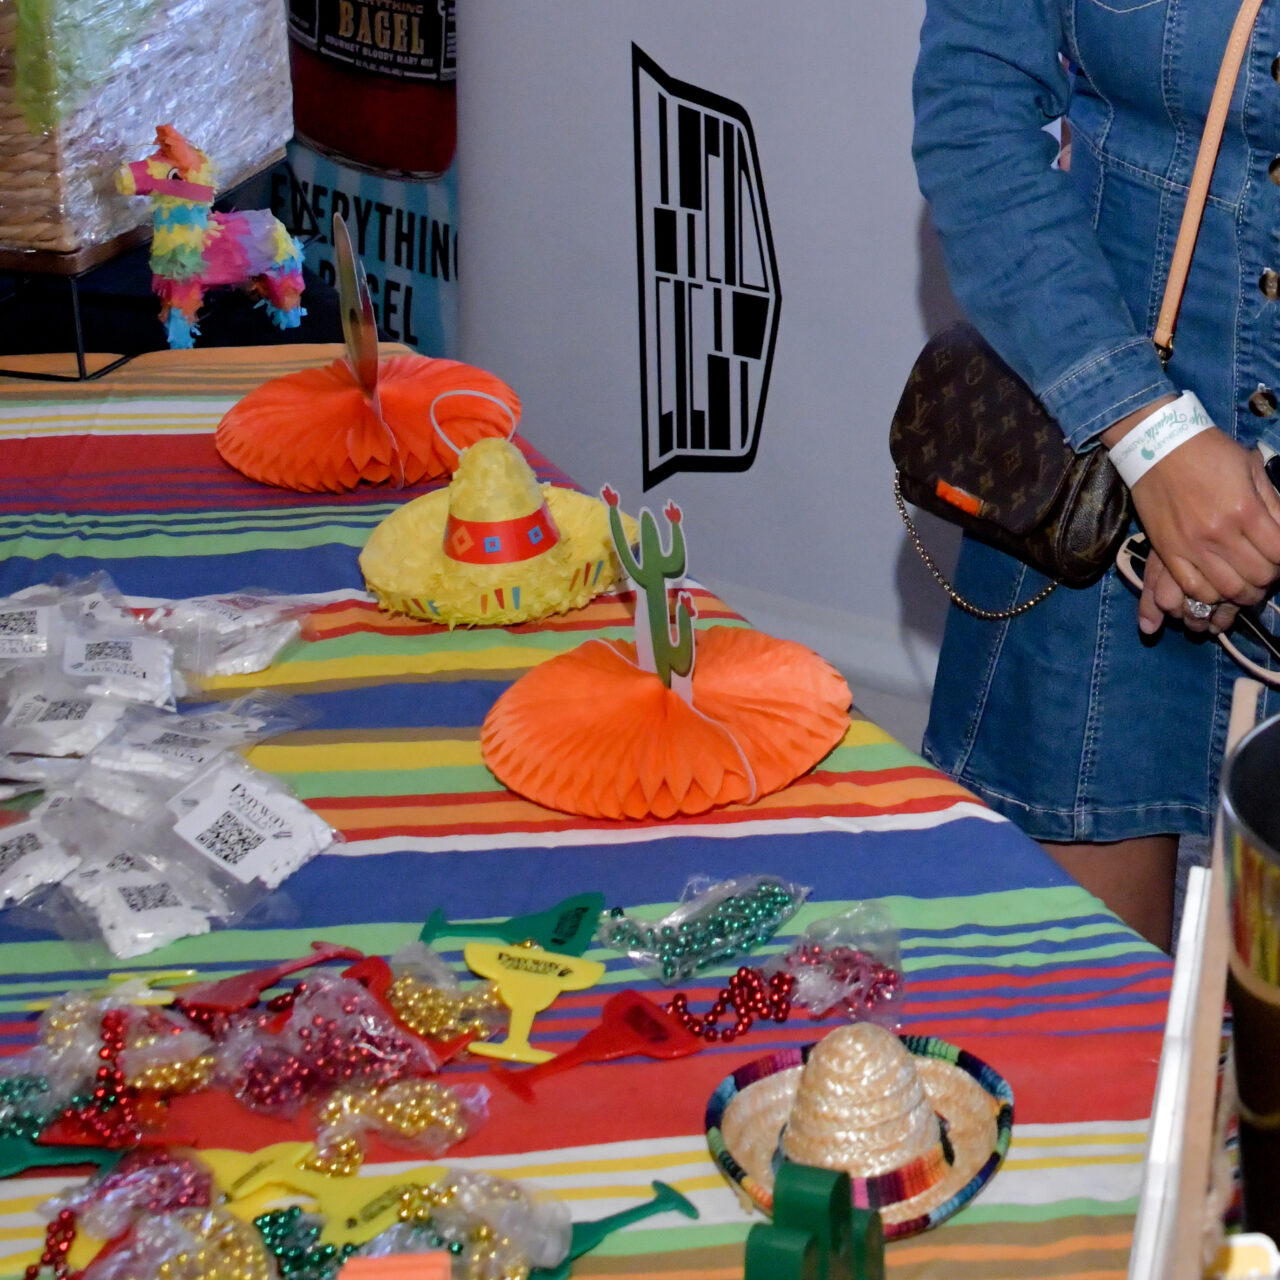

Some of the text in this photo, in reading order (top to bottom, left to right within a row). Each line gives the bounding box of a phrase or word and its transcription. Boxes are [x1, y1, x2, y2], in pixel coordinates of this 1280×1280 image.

[362, 46, 395, 63] BLOODY
[270, 173, 458, 282] EVERYTHIN
[1143, 409, 1188, 441] Tequila
